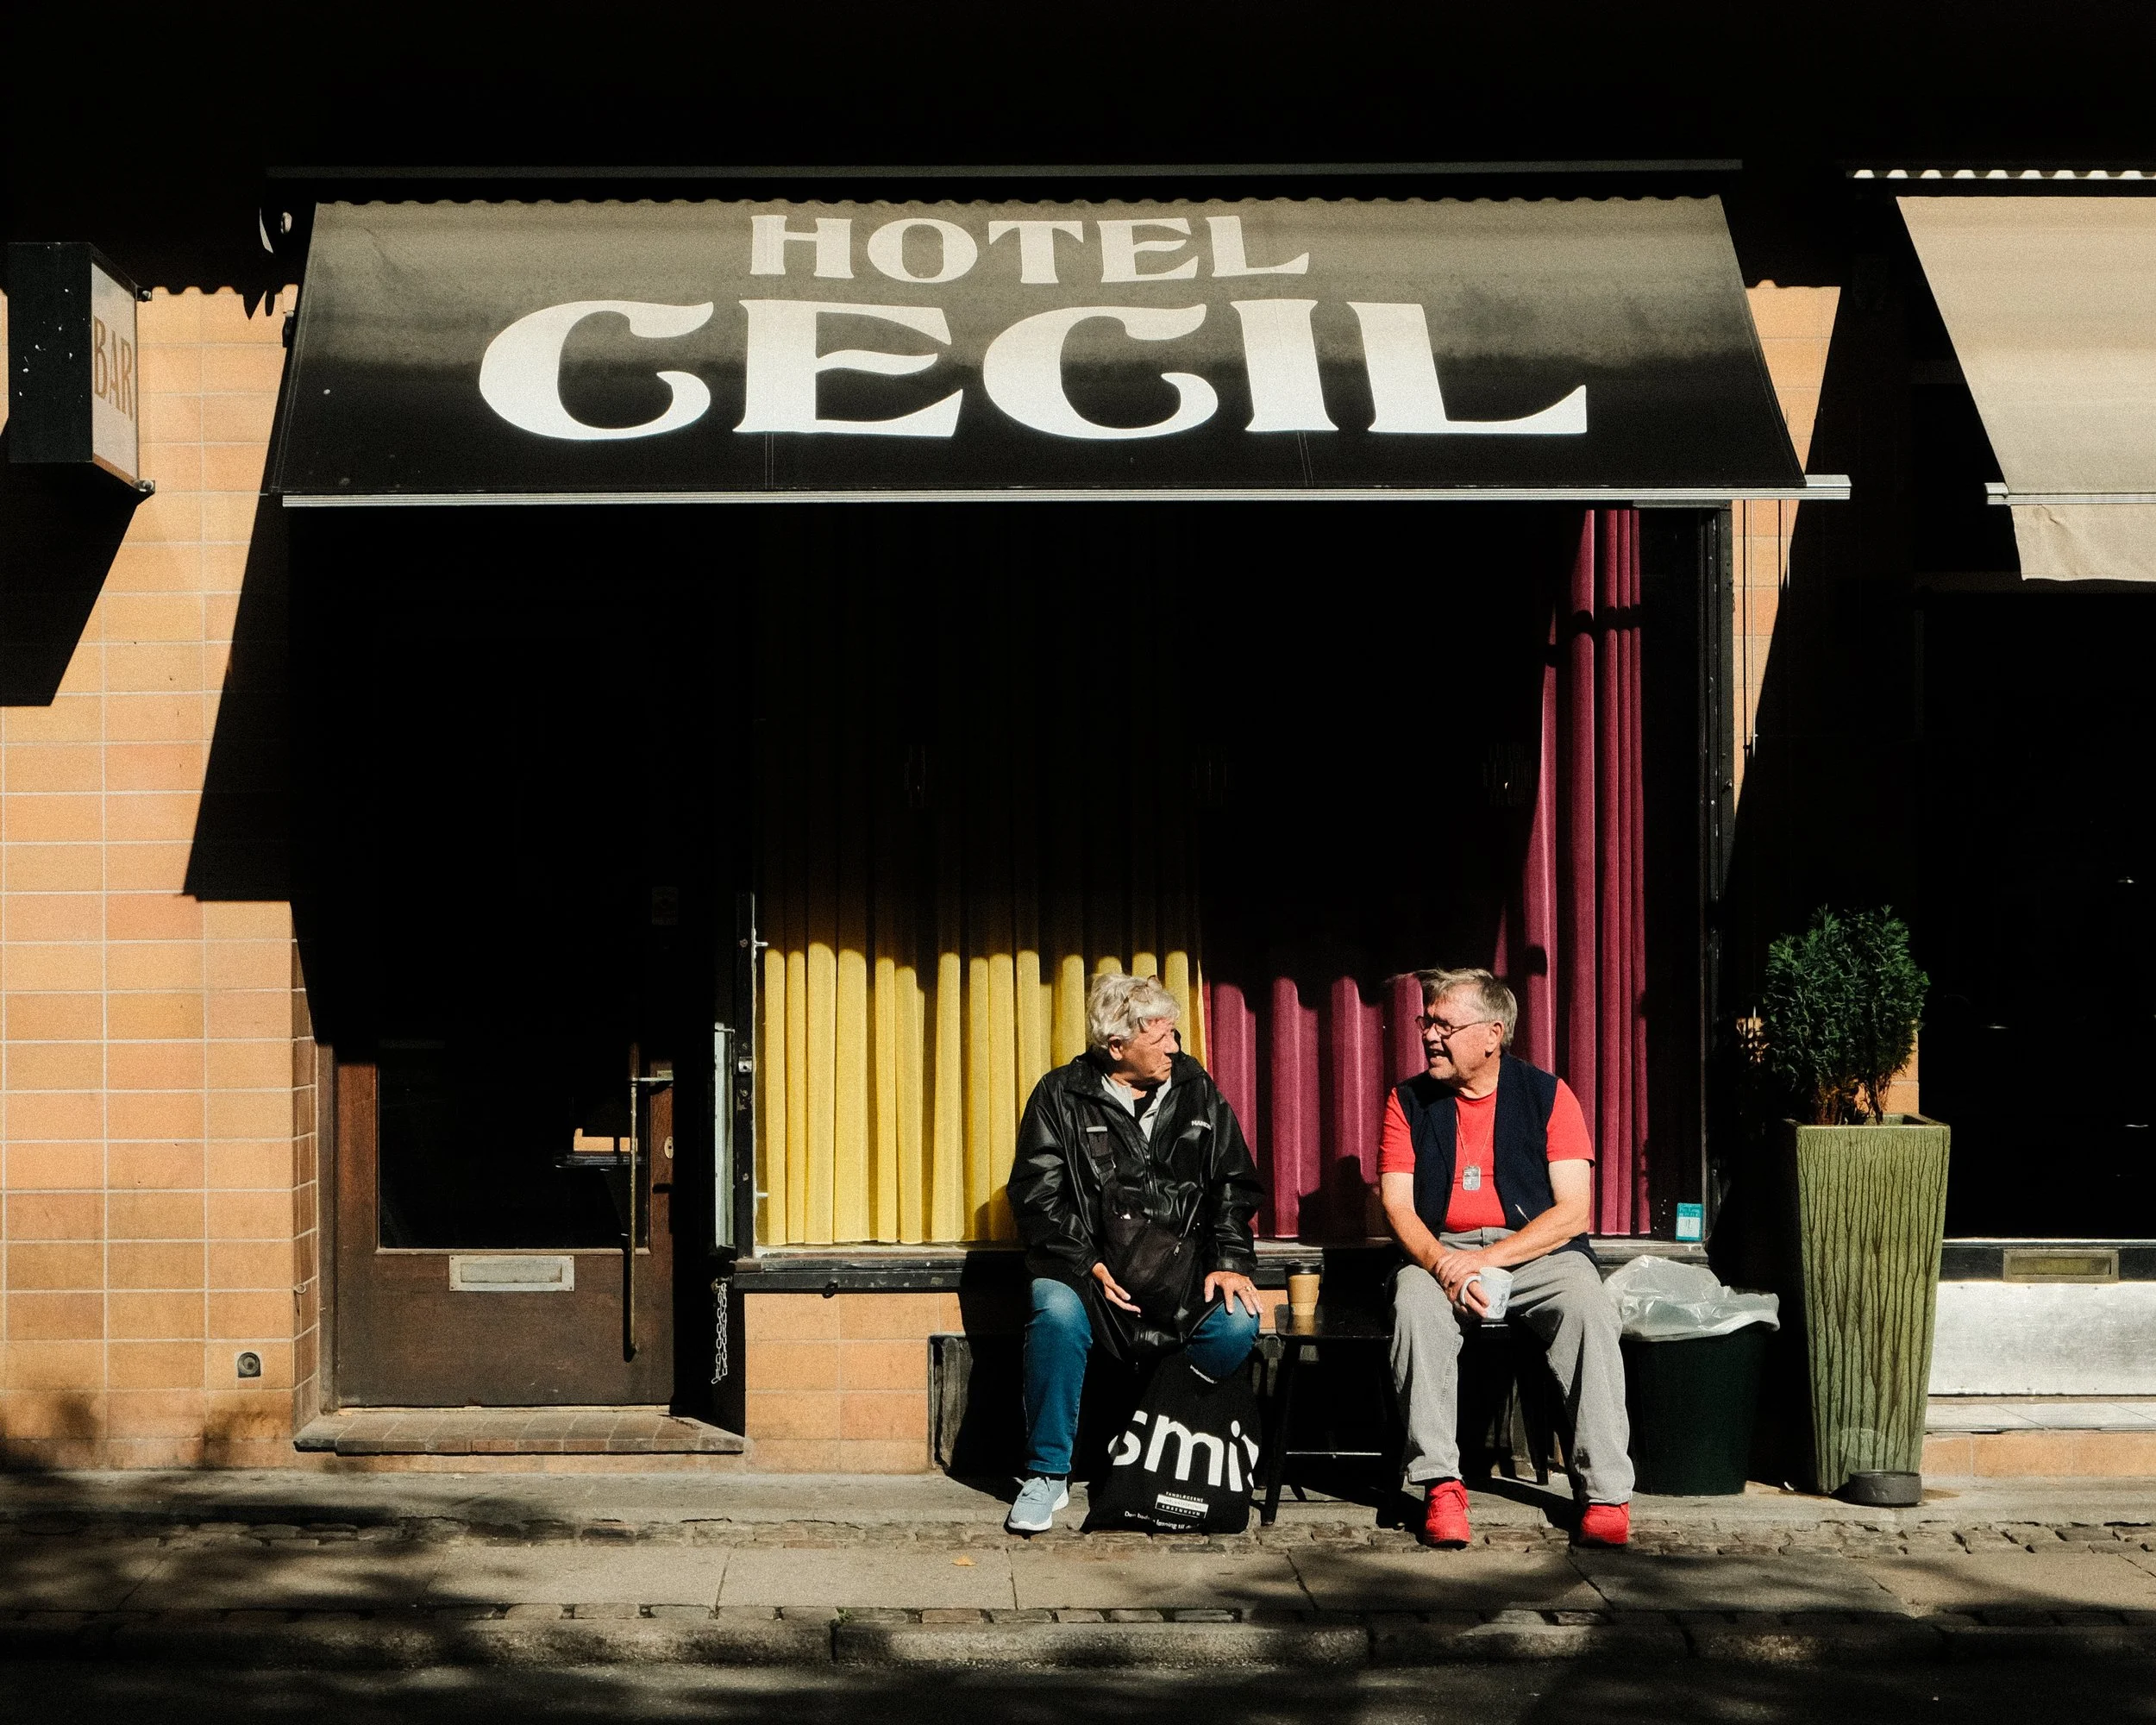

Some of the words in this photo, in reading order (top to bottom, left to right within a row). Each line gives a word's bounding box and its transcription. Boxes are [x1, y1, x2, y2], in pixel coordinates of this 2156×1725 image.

[749, 213, 1310, 283] HOTEL
[93, 314, 134, 422] BAR
[479, 298, 1588, 441] CECIL
